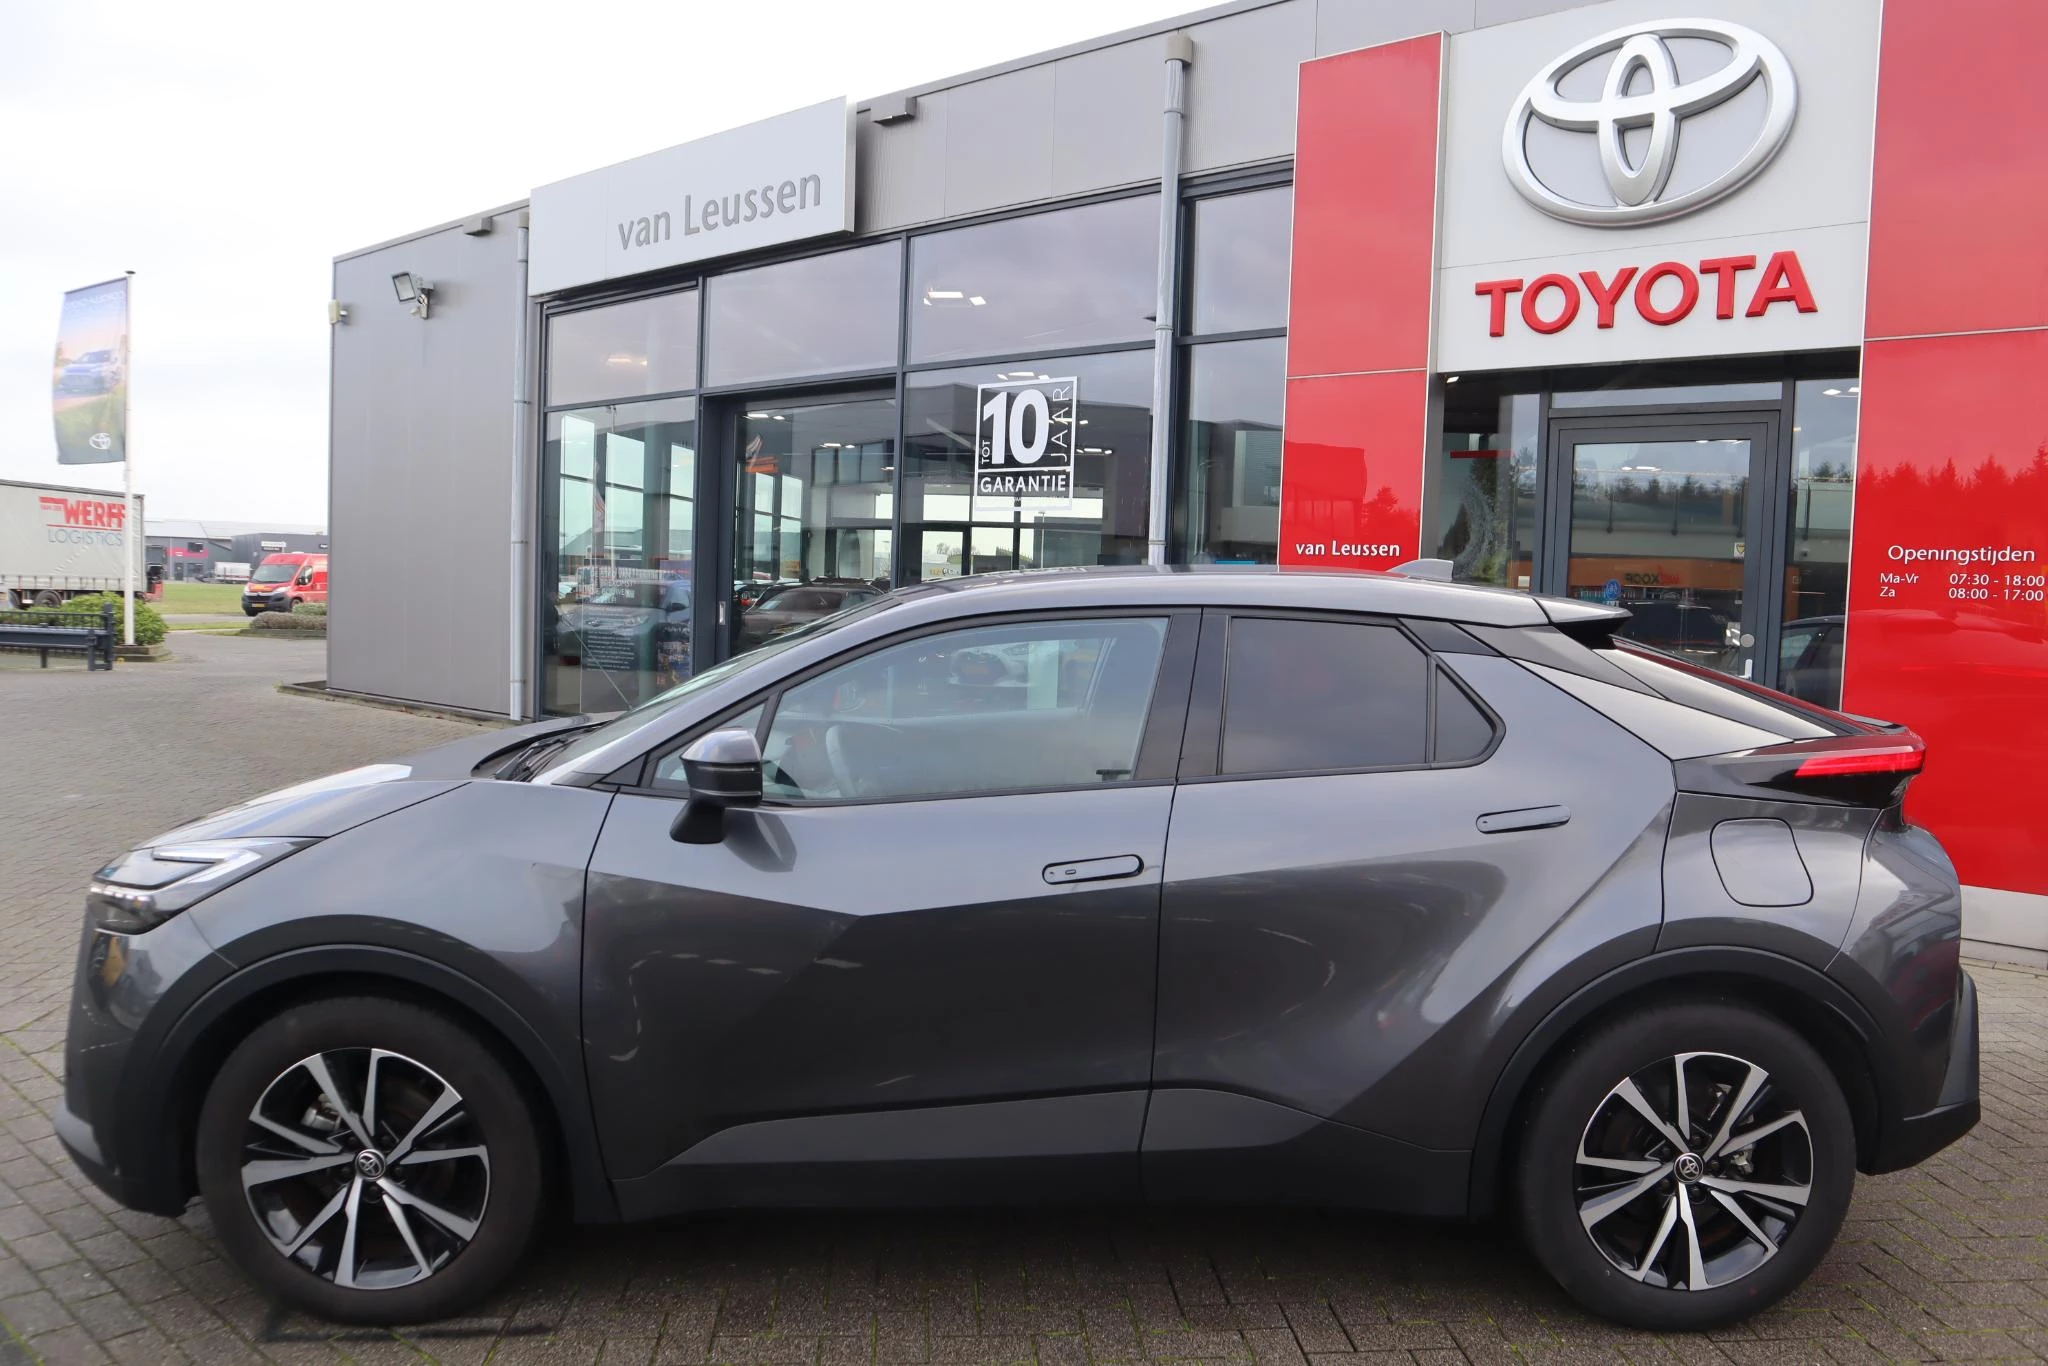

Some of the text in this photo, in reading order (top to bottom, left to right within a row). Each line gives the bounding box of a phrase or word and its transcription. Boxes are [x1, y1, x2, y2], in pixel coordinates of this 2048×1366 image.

[618, 174, 821, 250] van Leussen
[1475, 250, 1819, 338] TOYOTA
[983, 389, 1050, 465] 10
[1051, 385, 1070, 463] JAAR
[981, 440, 991, 465] TOT
[980, 475, 1067, 493] GARANTIE
[47, 528, 124, 547] LOGISTICS
[1295, 540, 1400, 557] van Leussen
[1888, 545, 2035, 566] Openingstijden
[1880, 572, 1919, 584] Ma-Vr
[1949, 573, 1990, 585] 07:30
[2005, 575, 2045, 587] 18:00
[1879, 586, 1896, 597] Za
[1948, 587, 1988, 599] 08:00
[2003, 589, 2044, 601] 17:00
